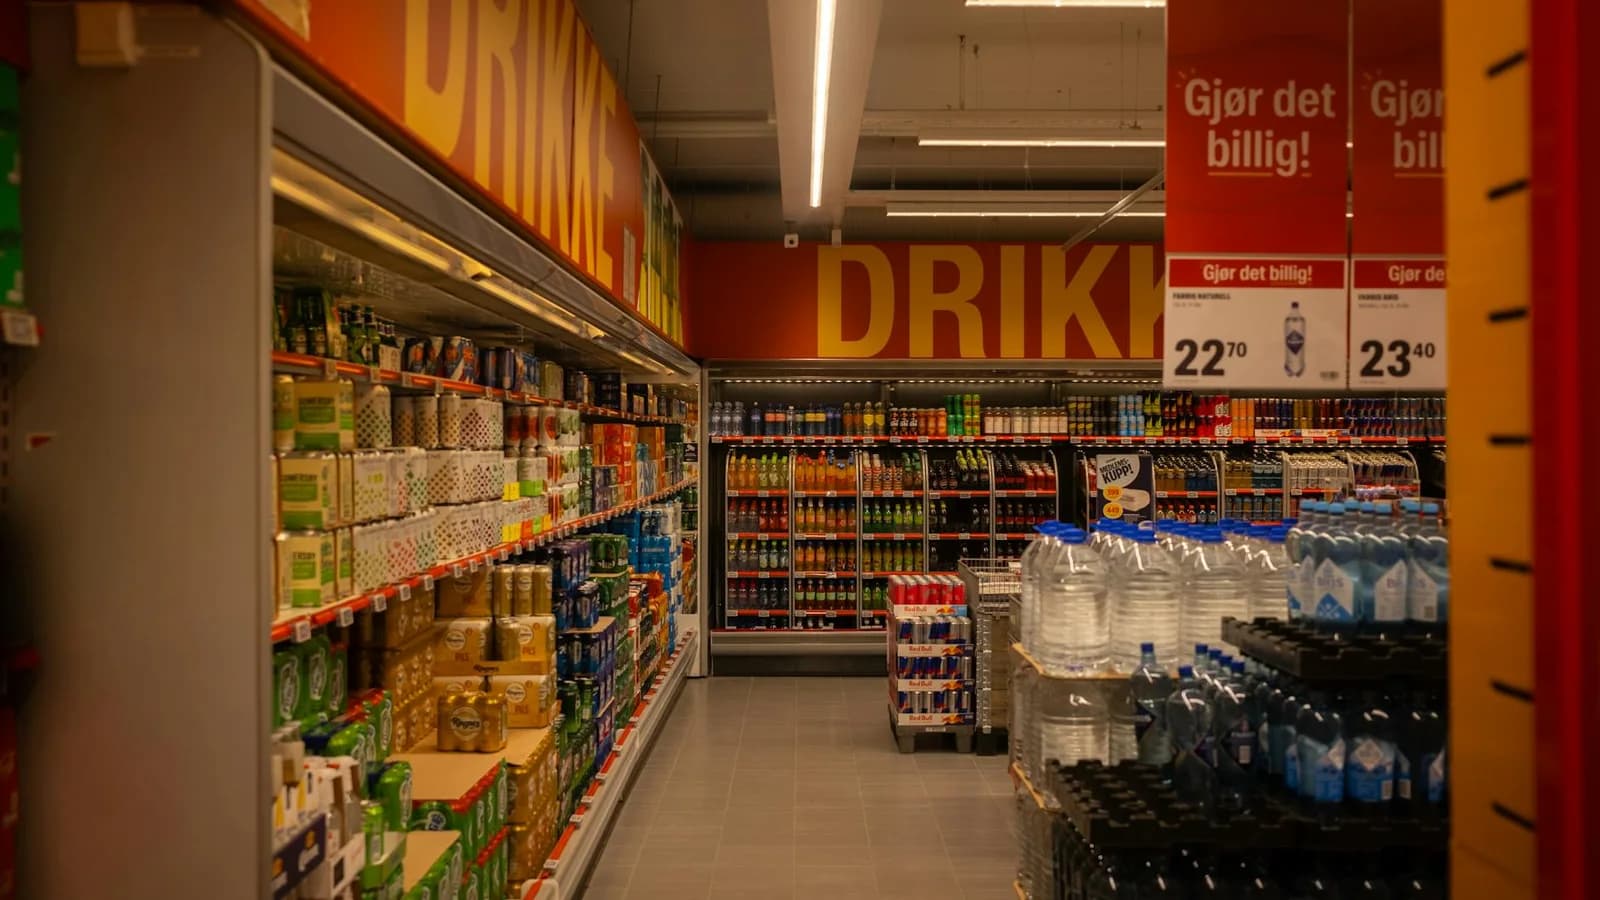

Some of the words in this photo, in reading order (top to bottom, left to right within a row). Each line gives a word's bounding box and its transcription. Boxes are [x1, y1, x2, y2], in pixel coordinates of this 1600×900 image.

[1184, 78, 1264, 126] Gjør
[1273, 80, 1336, 118] det
[1208, 129, 1311, 178] billig!
[1203, 264, 1235, 284] Gjør
[1239, 265, 1266, 281] det
[1269, 265, 1312, 284] billig!
[1388, 265, 1420, 284] Gjør
[1174, 339, 1225, 376] 22
[1227, 342, 1248, 358] 70
[1360, 340, 1411, 377] 23
[1413, 342, 1435, 358] 40
[1102, 463, 1134, 484] KUPP!
